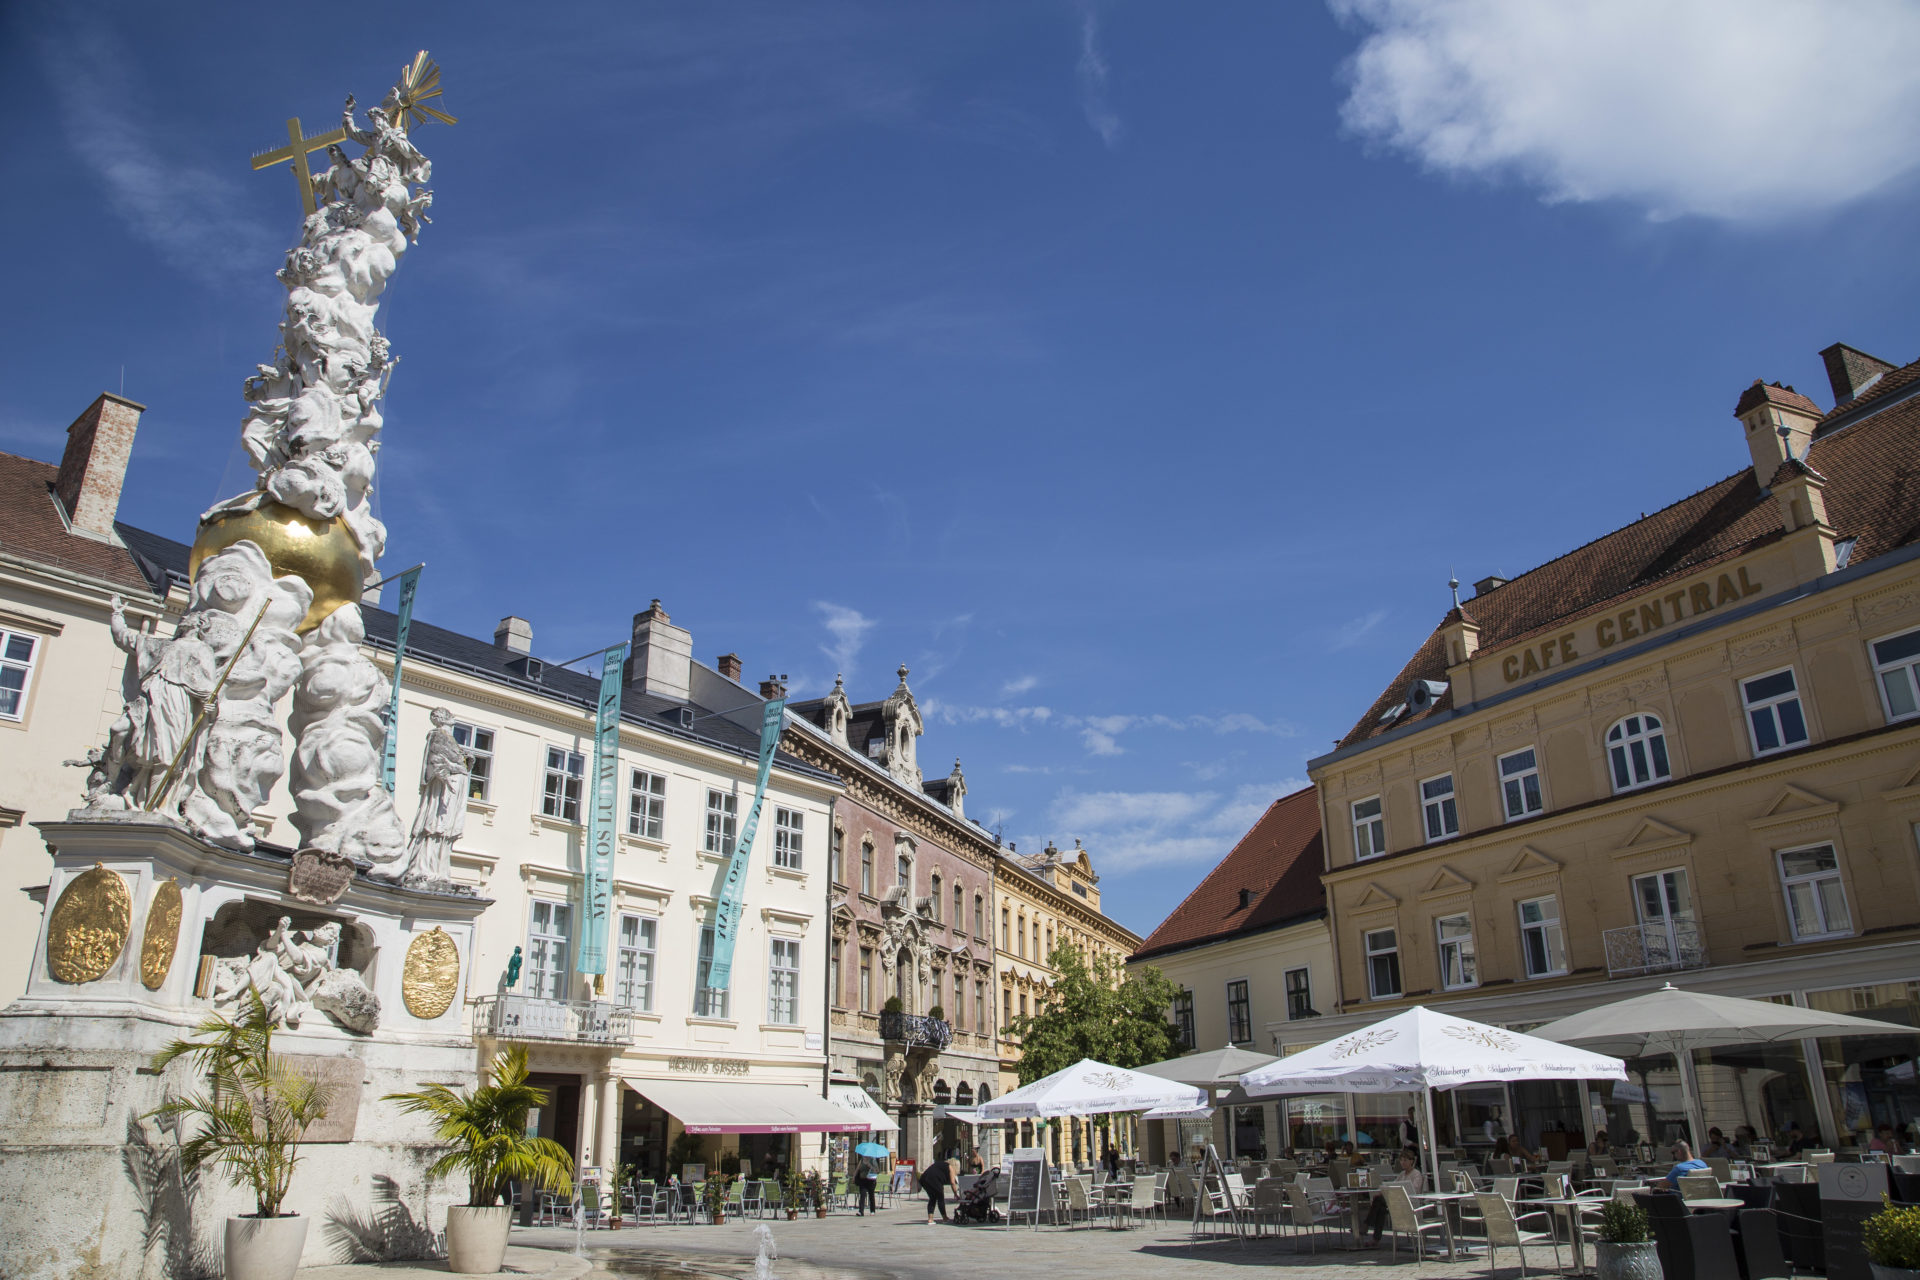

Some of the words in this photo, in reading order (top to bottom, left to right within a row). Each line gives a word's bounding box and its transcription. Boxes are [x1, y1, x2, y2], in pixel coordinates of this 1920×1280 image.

[1502, 632, 1578, 683] CAFE
[1596, 566, 1762, 648] CENTRAL
[602, 694, 617, 733] VAN
[597, 738, 616, 823] LUDWIG
[593, 830, 611, 920] MYTHOS
[668, 1056, 708, 1074] HERWIG
[712, 1058, 750, 1077] GASSER
[1429, 1066, 1471, 1078] Schlumberger
[1487, 1063, 1525, 1075] Schlumberger
[1541, 1063, 1576, 1074] Schlumberger
[1086, 1100, 1117, 1110] Schlumberger
[1132, 1096, 1161, 1106] Schlumberger
